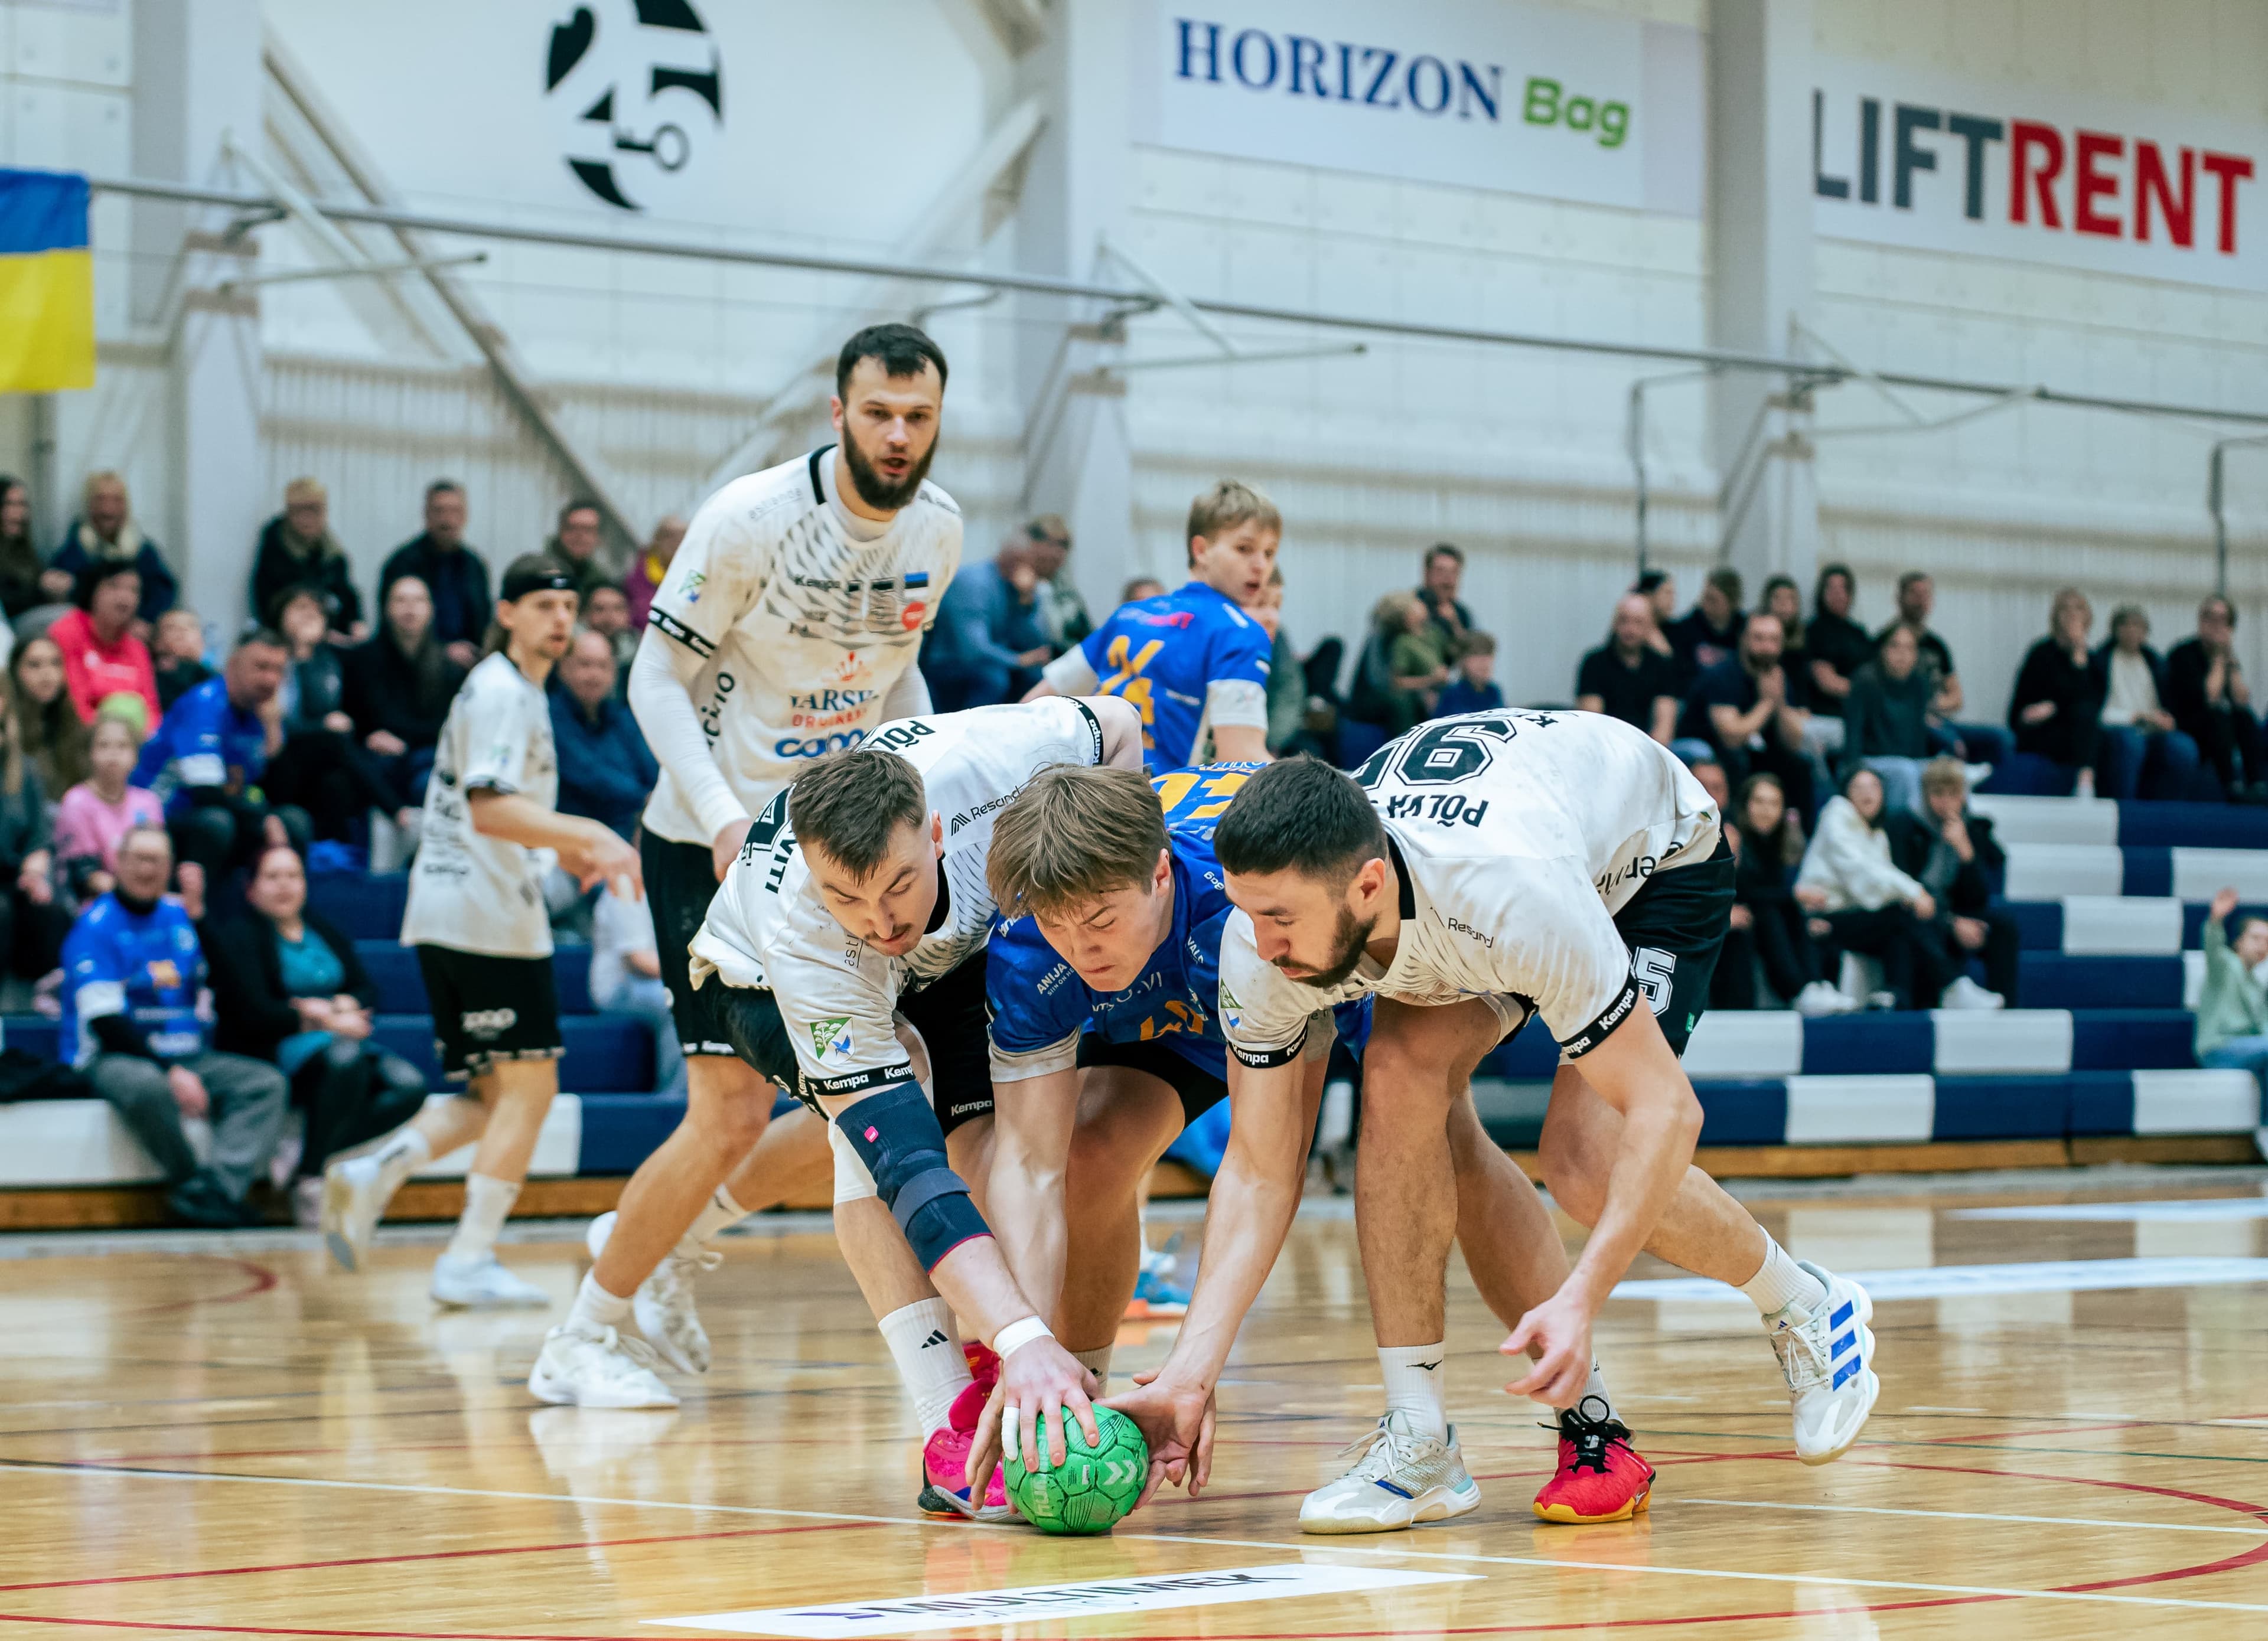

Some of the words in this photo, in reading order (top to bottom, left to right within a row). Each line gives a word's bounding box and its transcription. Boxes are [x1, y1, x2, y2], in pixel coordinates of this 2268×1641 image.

[1173, 17, 1505, 122] HORIZON
[1521, 76, 1631, 149] Bag
[1812, 87, 2255, 255] LIFTRENT
[875, 719, 937, 752] PÕL
[970, 784, 1022, 821] Resand
[764, 831, 796, 895] VITI
[1037, 963, 1068, 995] ANIJA
[1047, 983, 1059, 997] SIIN
[1058, 975, 1067, 985] ON
[1065, 967, 1075, 977] HE
[1598, 988, 1635, 1030] Kempa
[1232, 1043, 1269, 1066] Kempa
[823, 1072, 869, 1091] Kempa
[884, 1064, 914, 1081] Kemp
[951, 1098, 993, 1117] Kempa
[858, 1574, 1302, 1614] MULTIMEK
